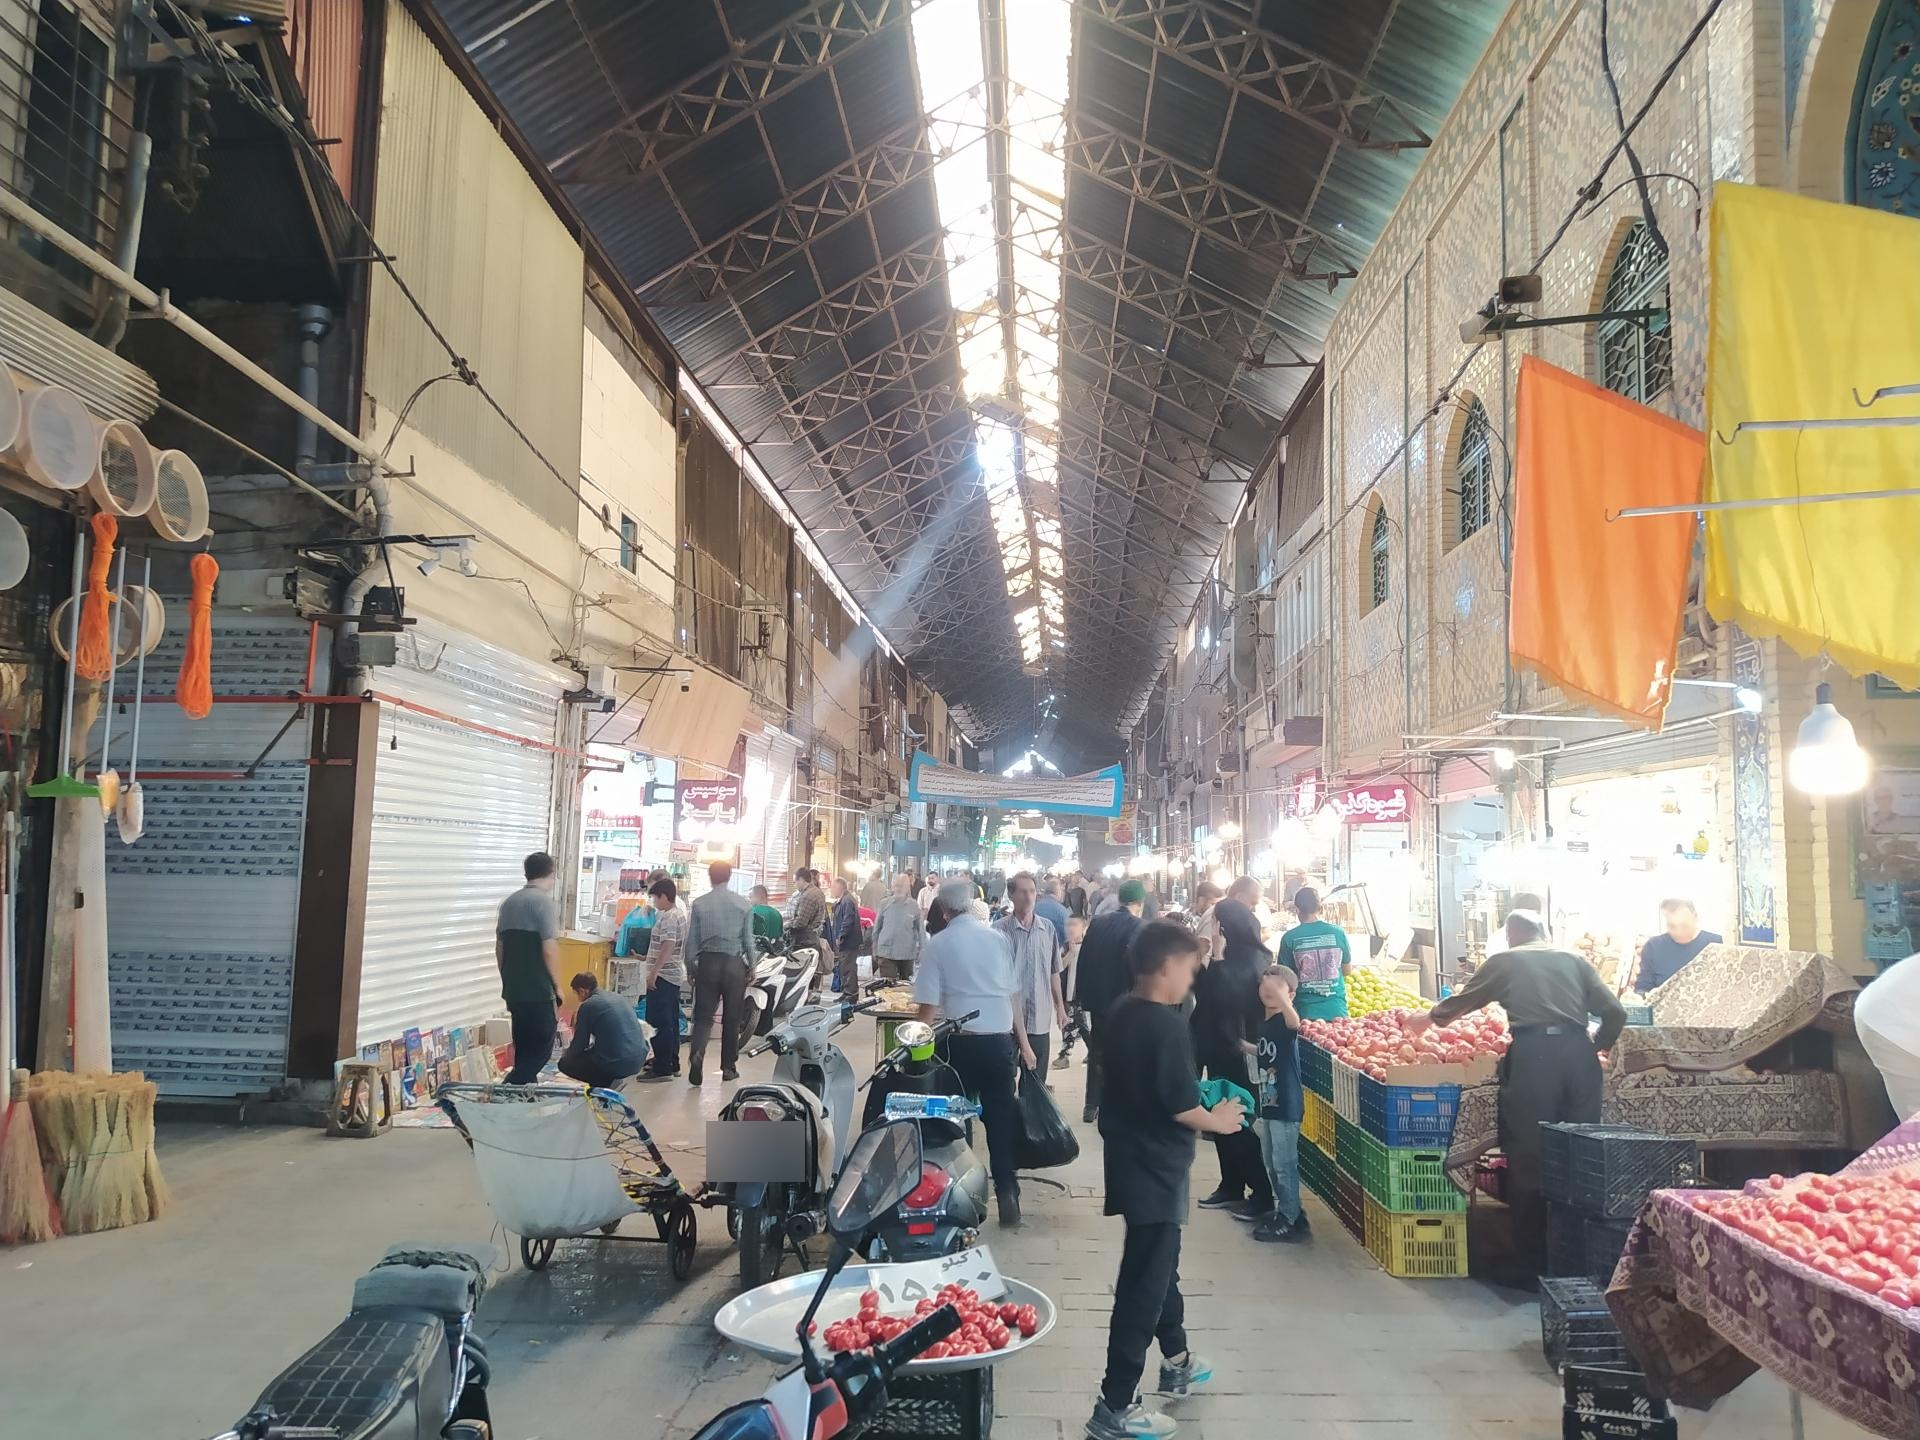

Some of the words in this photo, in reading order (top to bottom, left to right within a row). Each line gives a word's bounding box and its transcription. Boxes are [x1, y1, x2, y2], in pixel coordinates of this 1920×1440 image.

[683, 786, 737, 800] سوسیس
[1367, 788, 1407, 821] قهوه
[941, 1251, 970, 1272] کیلو
